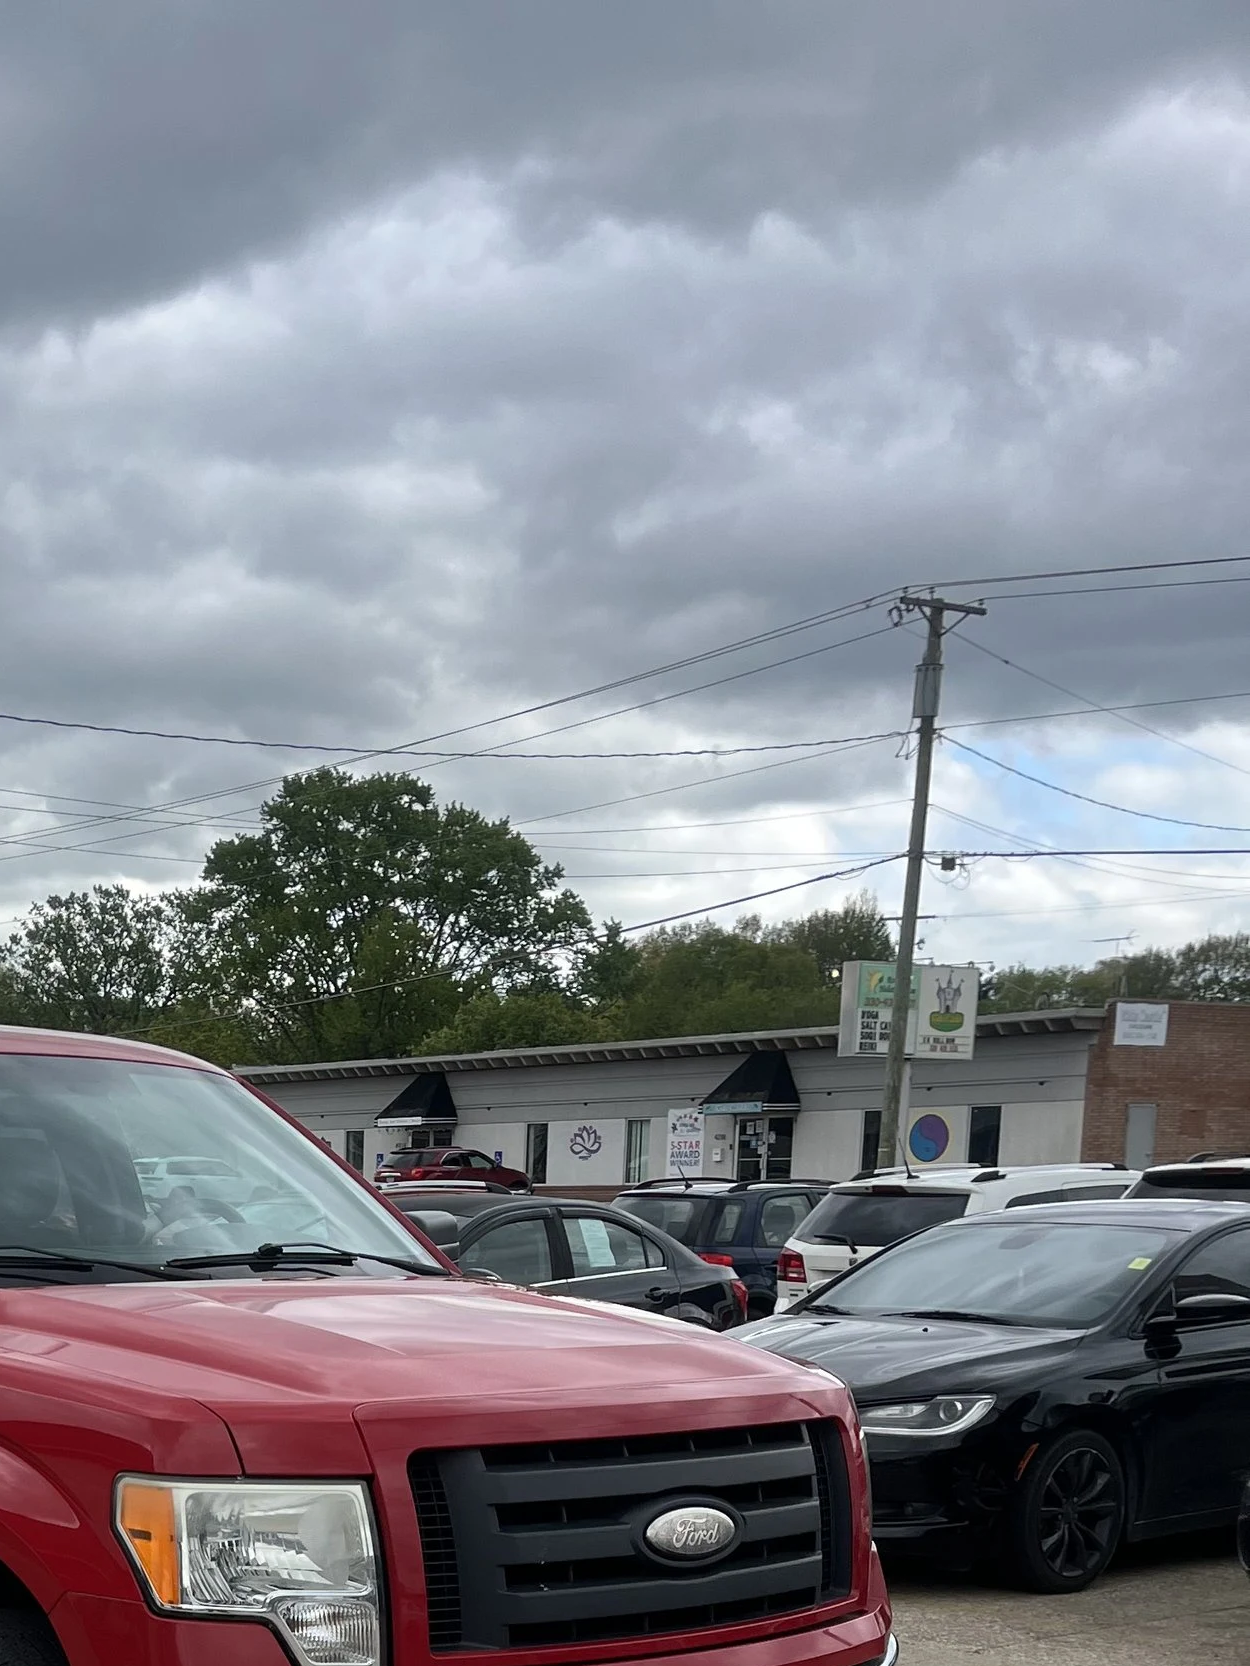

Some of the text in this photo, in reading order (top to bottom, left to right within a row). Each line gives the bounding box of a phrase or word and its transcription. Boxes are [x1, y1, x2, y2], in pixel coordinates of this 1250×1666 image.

[860, 1020, 878, 1030] SALT
[670, 1140, 701, 1150] 5-STAR
[670, 1150, 701, 1159] AWARD
[672, 1517, 719, 1548] Ford
